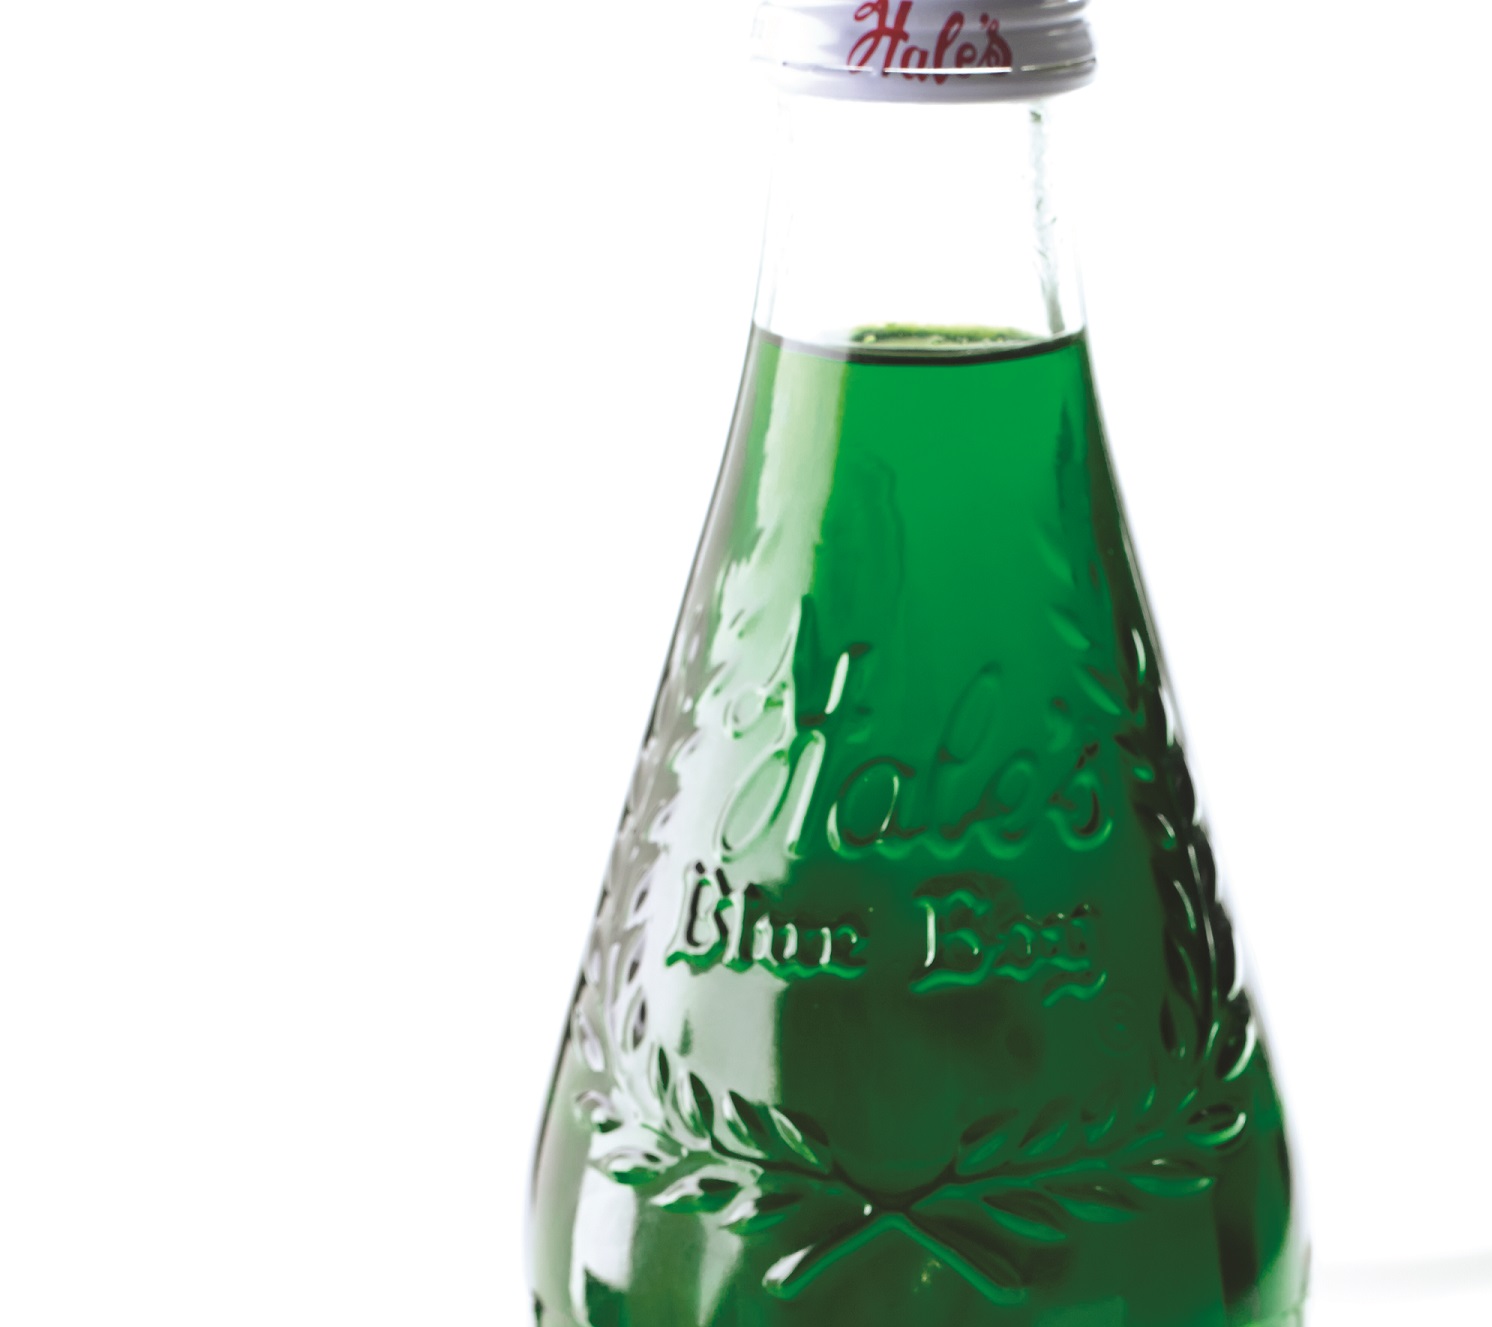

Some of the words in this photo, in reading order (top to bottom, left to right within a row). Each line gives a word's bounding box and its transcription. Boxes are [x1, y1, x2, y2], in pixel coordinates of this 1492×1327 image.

[847, 0, 1013, 84] Hale's
[664, 862, 870, 980] Blue
[908, 876, 1108, 1006] Boy
